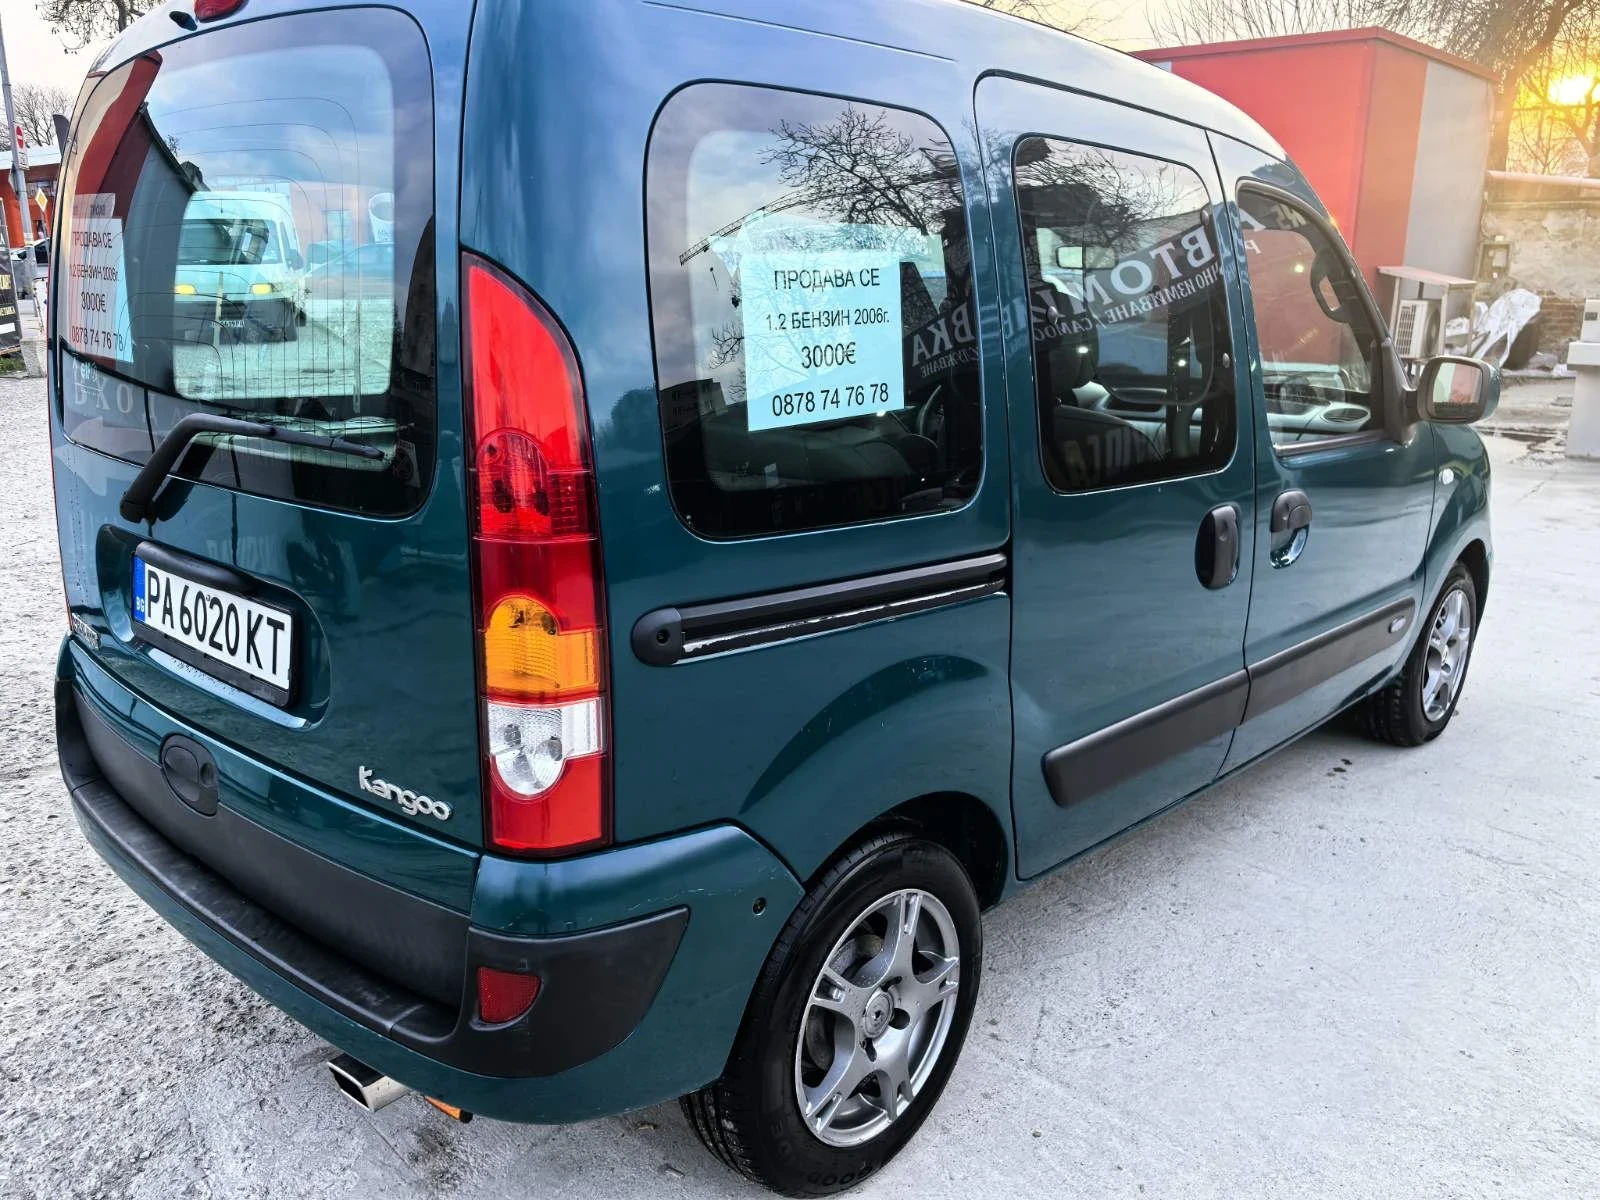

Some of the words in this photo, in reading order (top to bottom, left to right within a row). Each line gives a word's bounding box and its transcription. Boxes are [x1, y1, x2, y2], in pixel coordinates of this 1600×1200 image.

[73, 231, 102, 248] ПРОДАВА
[103, 232, 113, 249] СЕ
[774, 269, 855, 292] ПРОДАВА
[860, 268, 881, 287] СЕ
[81, 291, 106, 313] 3000€
[766, 313, 787, 331] 1.2
[791, 308, 850, 329] БЕНЗИН
[854, 307, 890, 325] 2006г.
[71, 326, 88, 345] 0878
[90, 329, 100, 345] 74
[102, 331, 112, 349] 76
[801, 341, 856, 369] 3000€
[772, 391, 816, 417] 0878
[820, 387, 840, 411] 74
[845, 385, 865, 407] 76
[869, 383, 889, 404] 78
